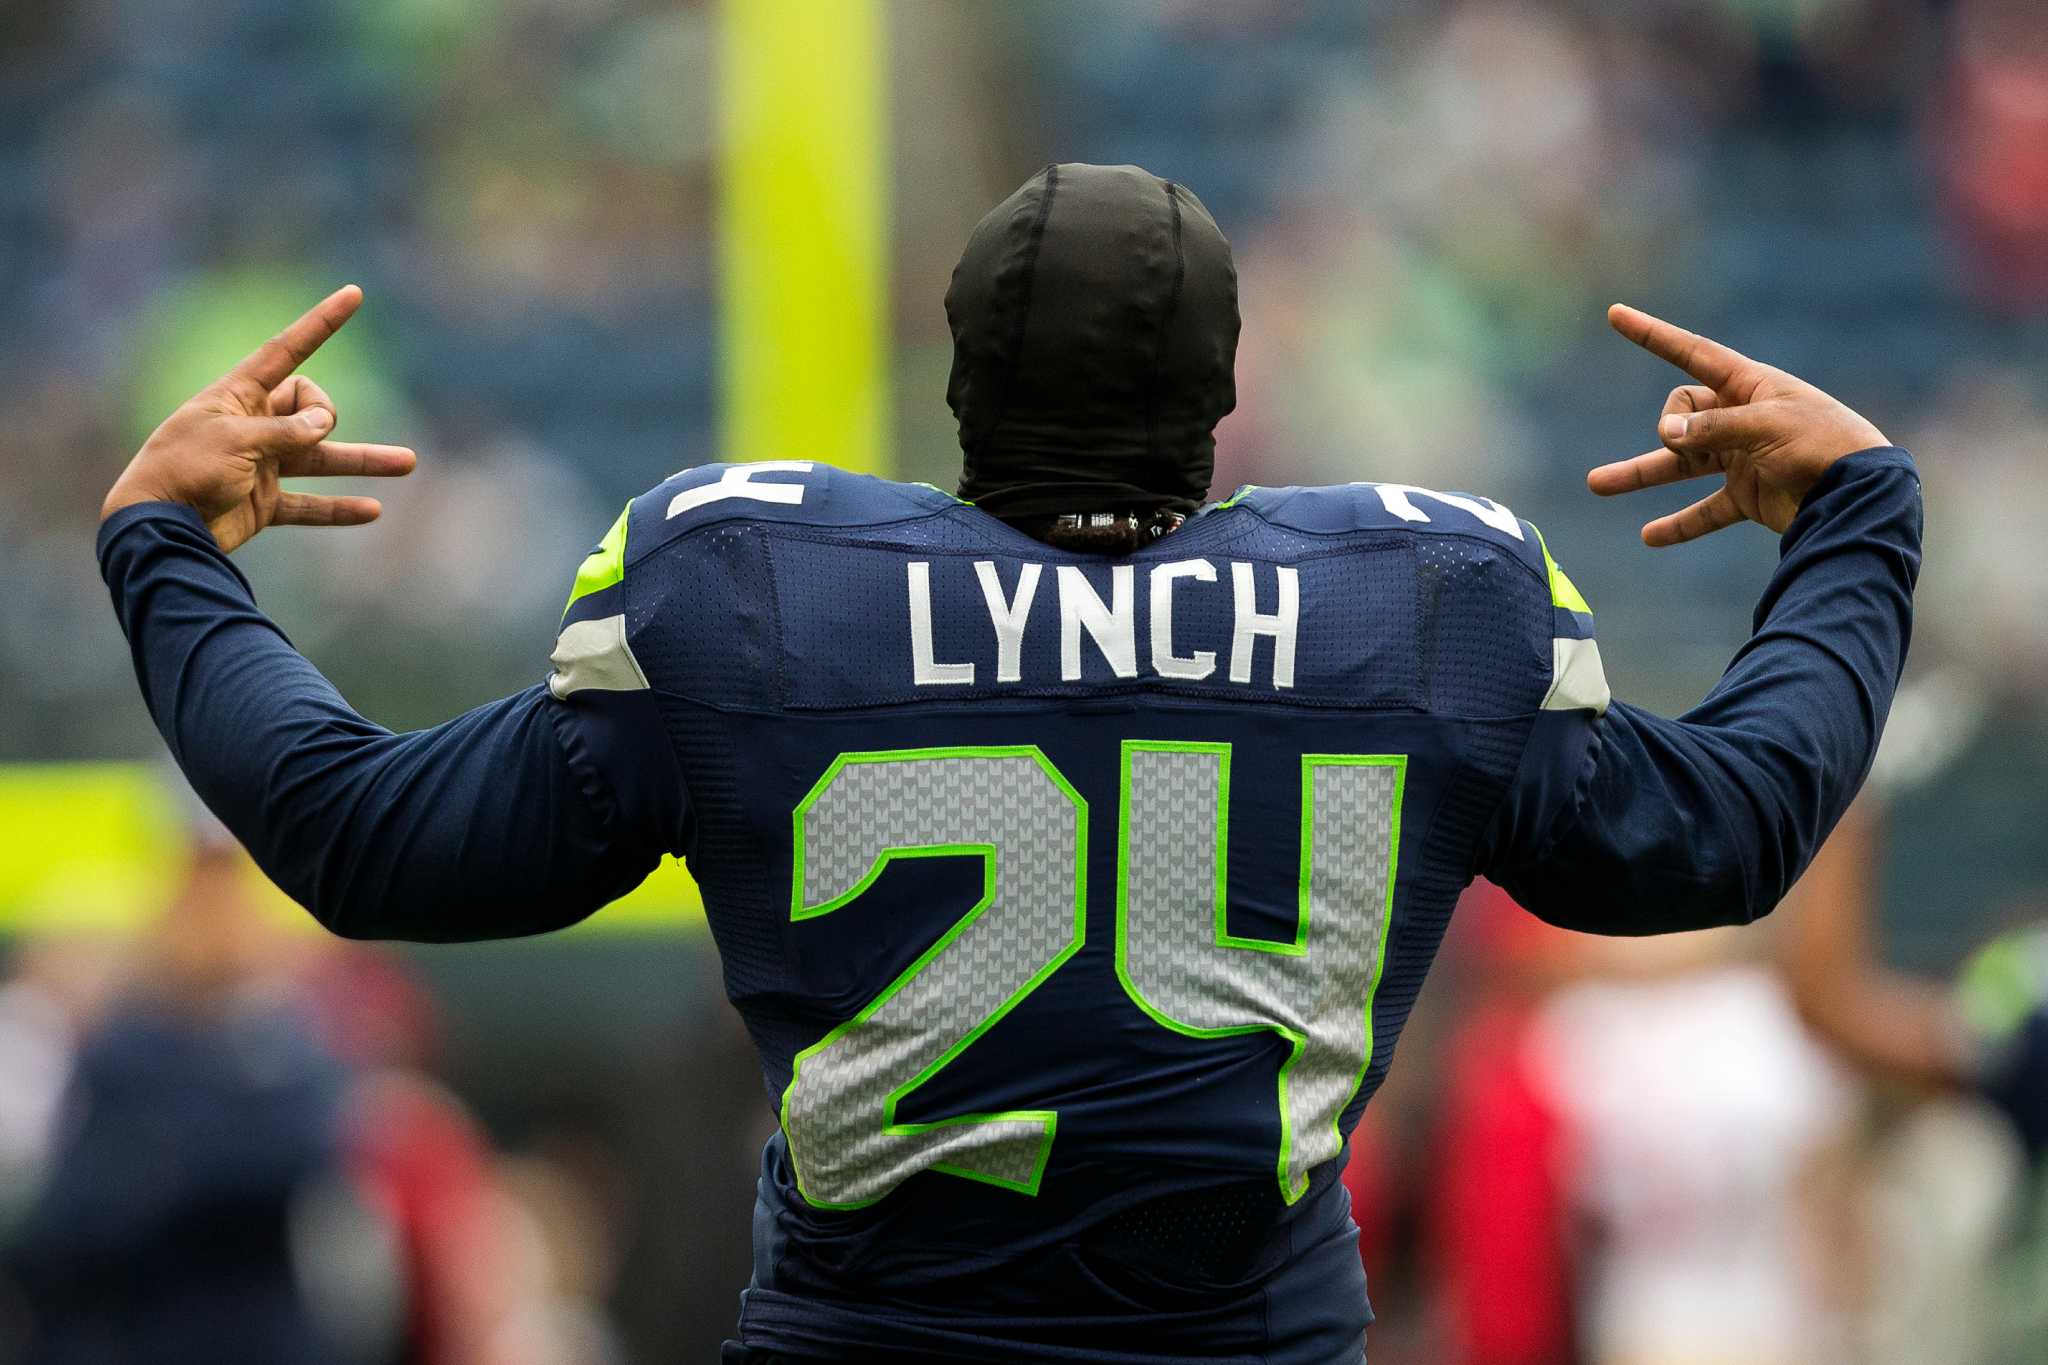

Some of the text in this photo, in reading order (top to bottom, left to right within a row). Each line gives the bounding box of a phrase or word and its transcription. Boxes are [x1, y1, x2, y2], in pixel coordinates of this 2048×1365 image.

[664, 461, 814, 521] 4
[907, 557, 1300, 690] LYNCH
[781, 739, 1409, 1210] 24
